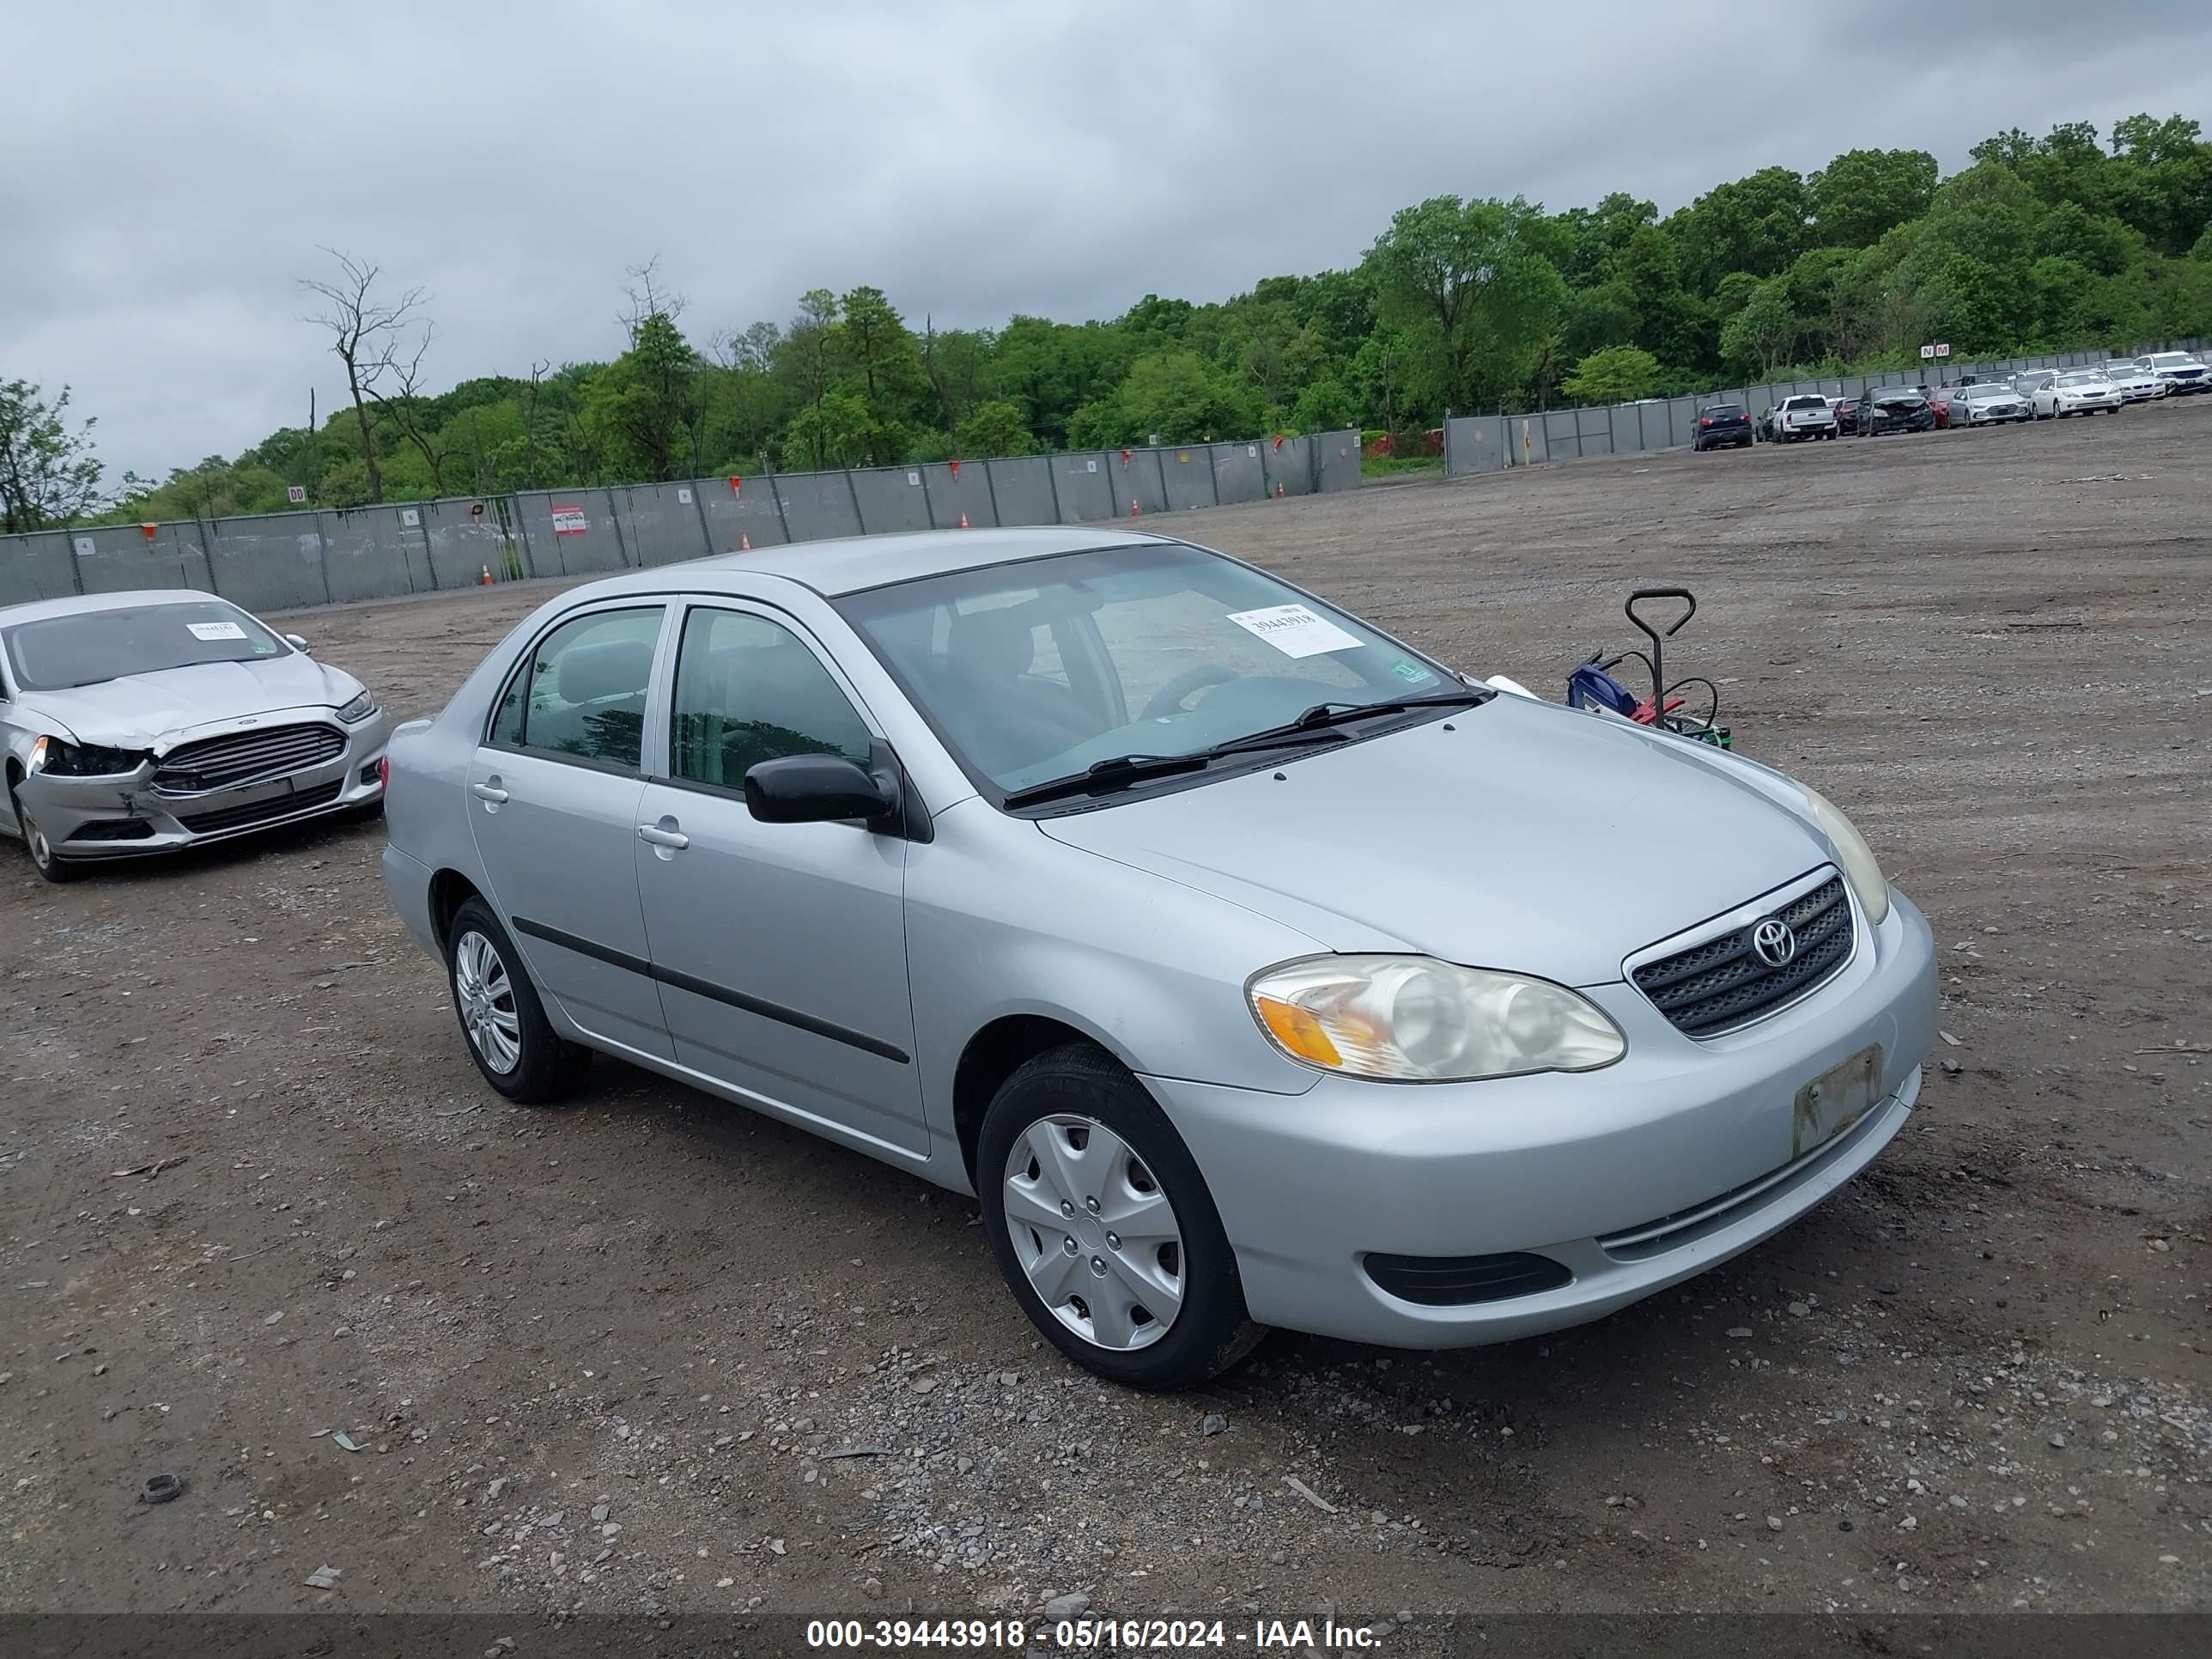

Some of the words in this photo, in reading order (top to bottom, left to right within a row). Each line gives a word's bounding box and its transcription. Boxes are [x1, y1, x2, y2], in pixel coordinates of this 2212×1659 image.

[1923, 348, 1931, 356] N
[1938, 346, 1948, 355] M
[290, 489, 303, 500] DD
[1251, 614, 1316, 632] 39443918
